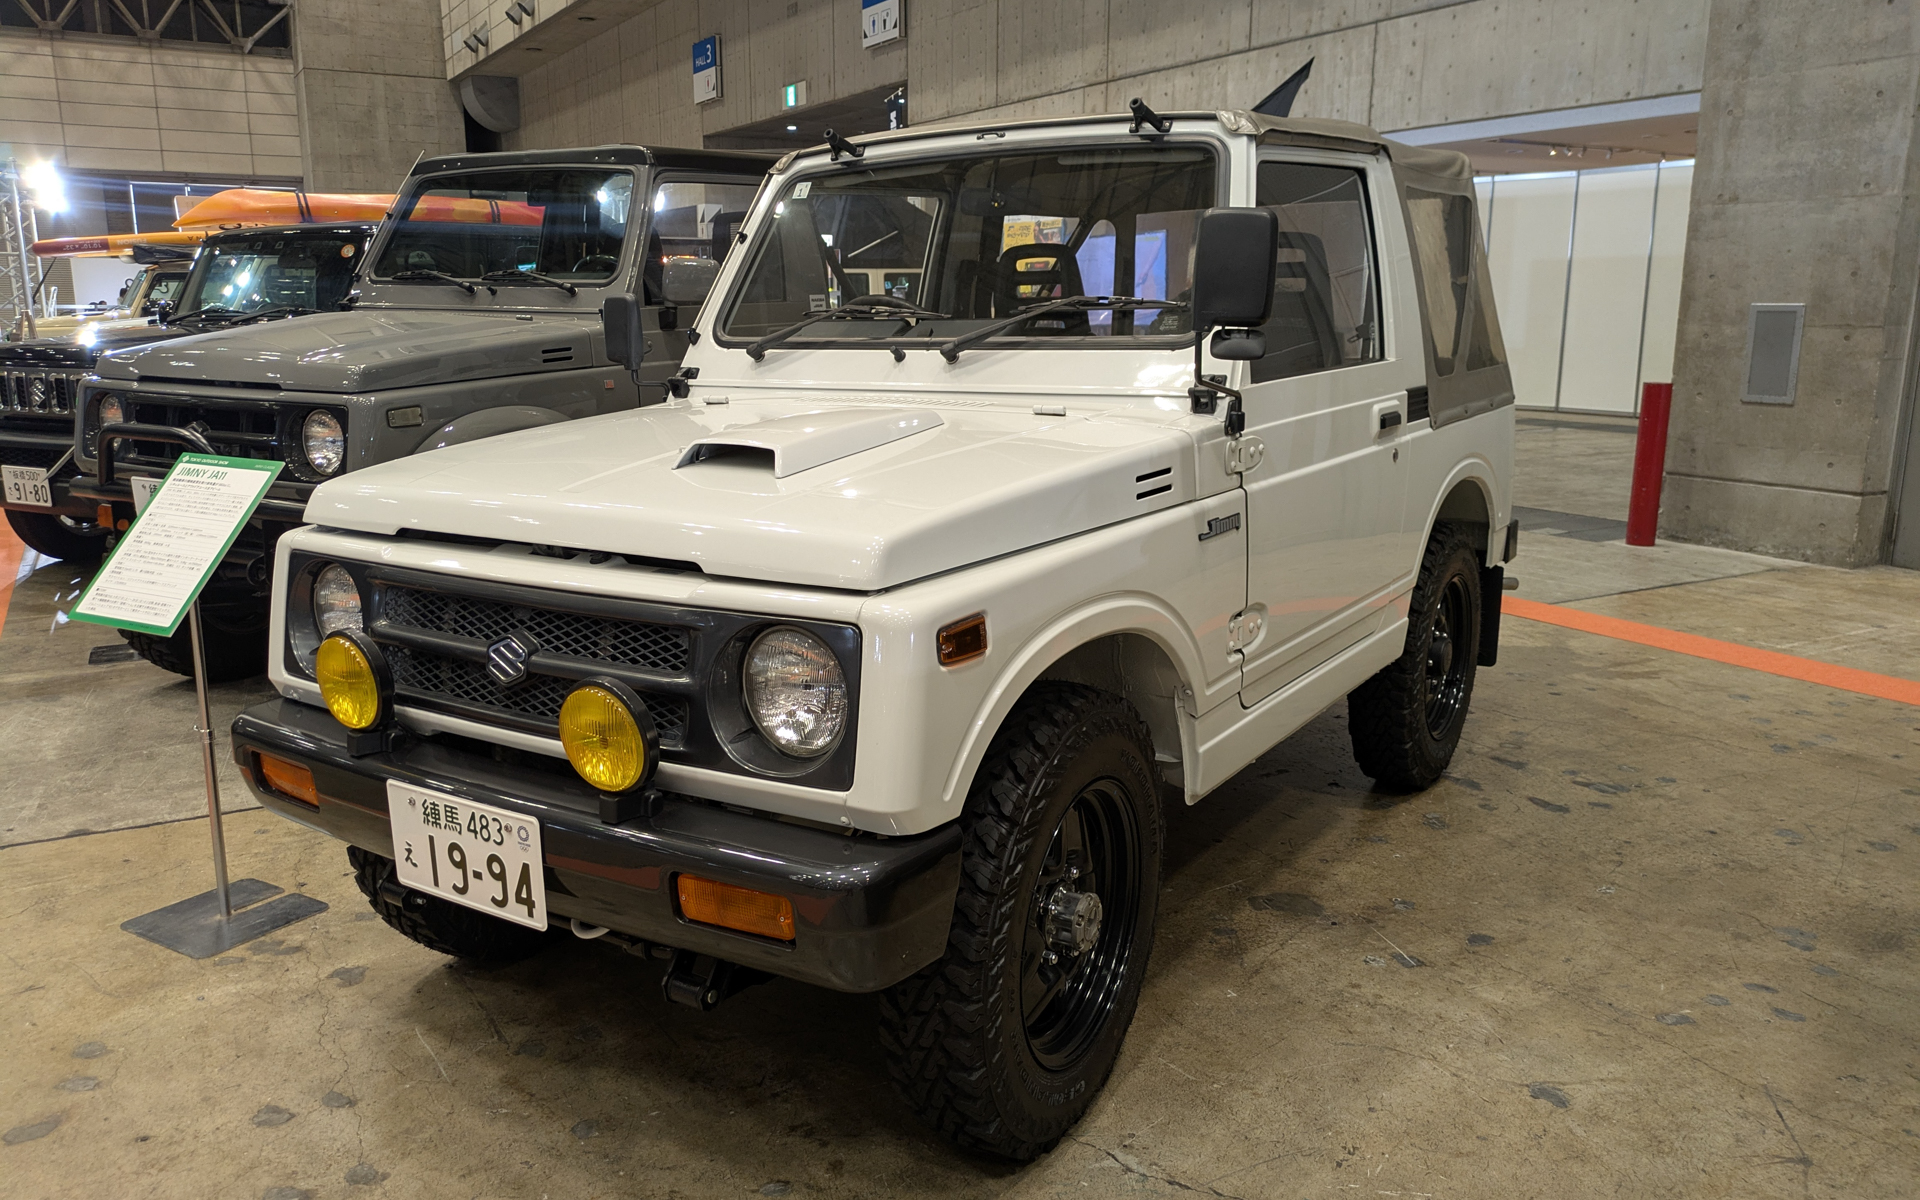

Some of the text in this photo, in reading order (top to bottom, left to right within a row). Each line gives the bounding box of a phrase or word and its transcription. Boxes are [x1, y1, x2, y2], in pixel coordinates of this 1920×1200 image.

[695, 44, 712, 67] HALL 3
[117, 238, 147, 246] FUSION
[26, 471, 39, 481] 500
[177, 467, 228, 480] JIMNY JA11
[14, 482, 49, 503] 91-80
[1198, 512, 1241, 541] Jimny
[421, 798, 504, 846] 練馬 483
[404, 834, 536, 919] え 19-94
